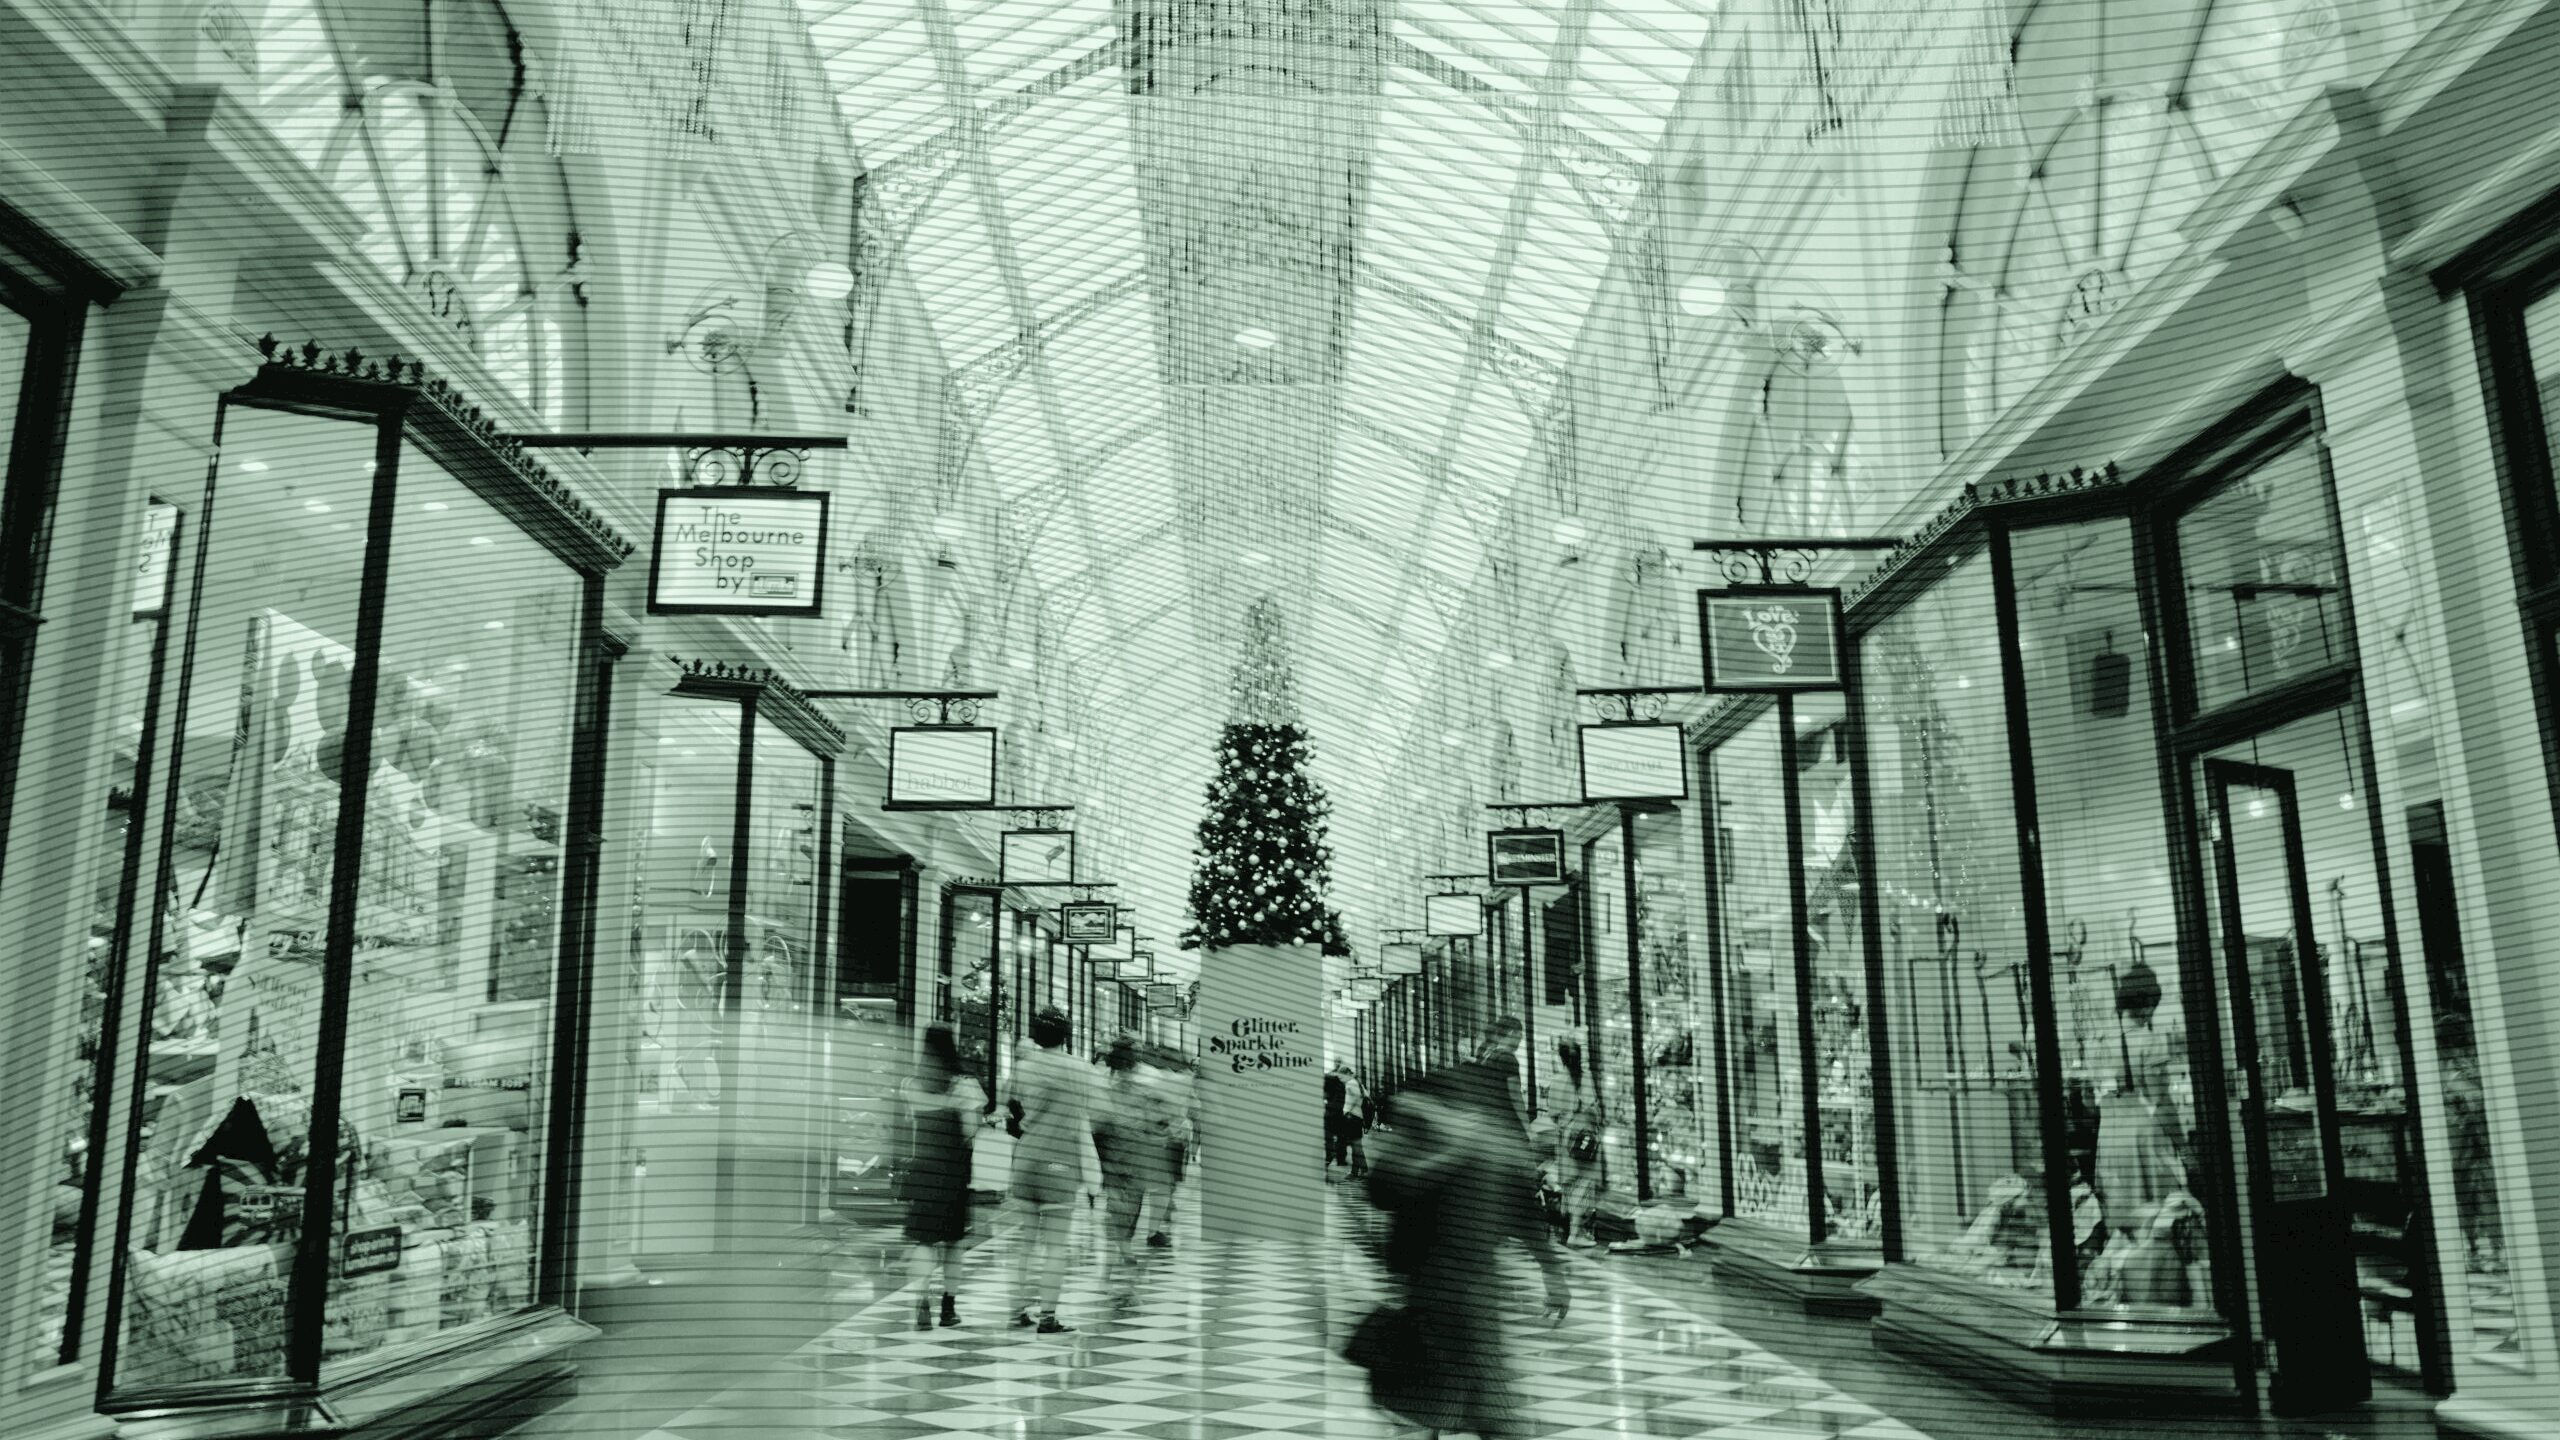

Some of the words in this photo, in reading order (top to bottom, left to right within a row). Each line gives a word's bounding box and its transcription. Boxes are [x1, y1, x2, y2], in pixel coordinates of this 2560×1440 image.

[701, 506, 742, 525] The
[676, 523, 804, 544] Melbourne
[695, 546, 754, 572] Shop
[716, 570, 744, 593] by
[1209, 1035, 1284, 1055] Sparkle
